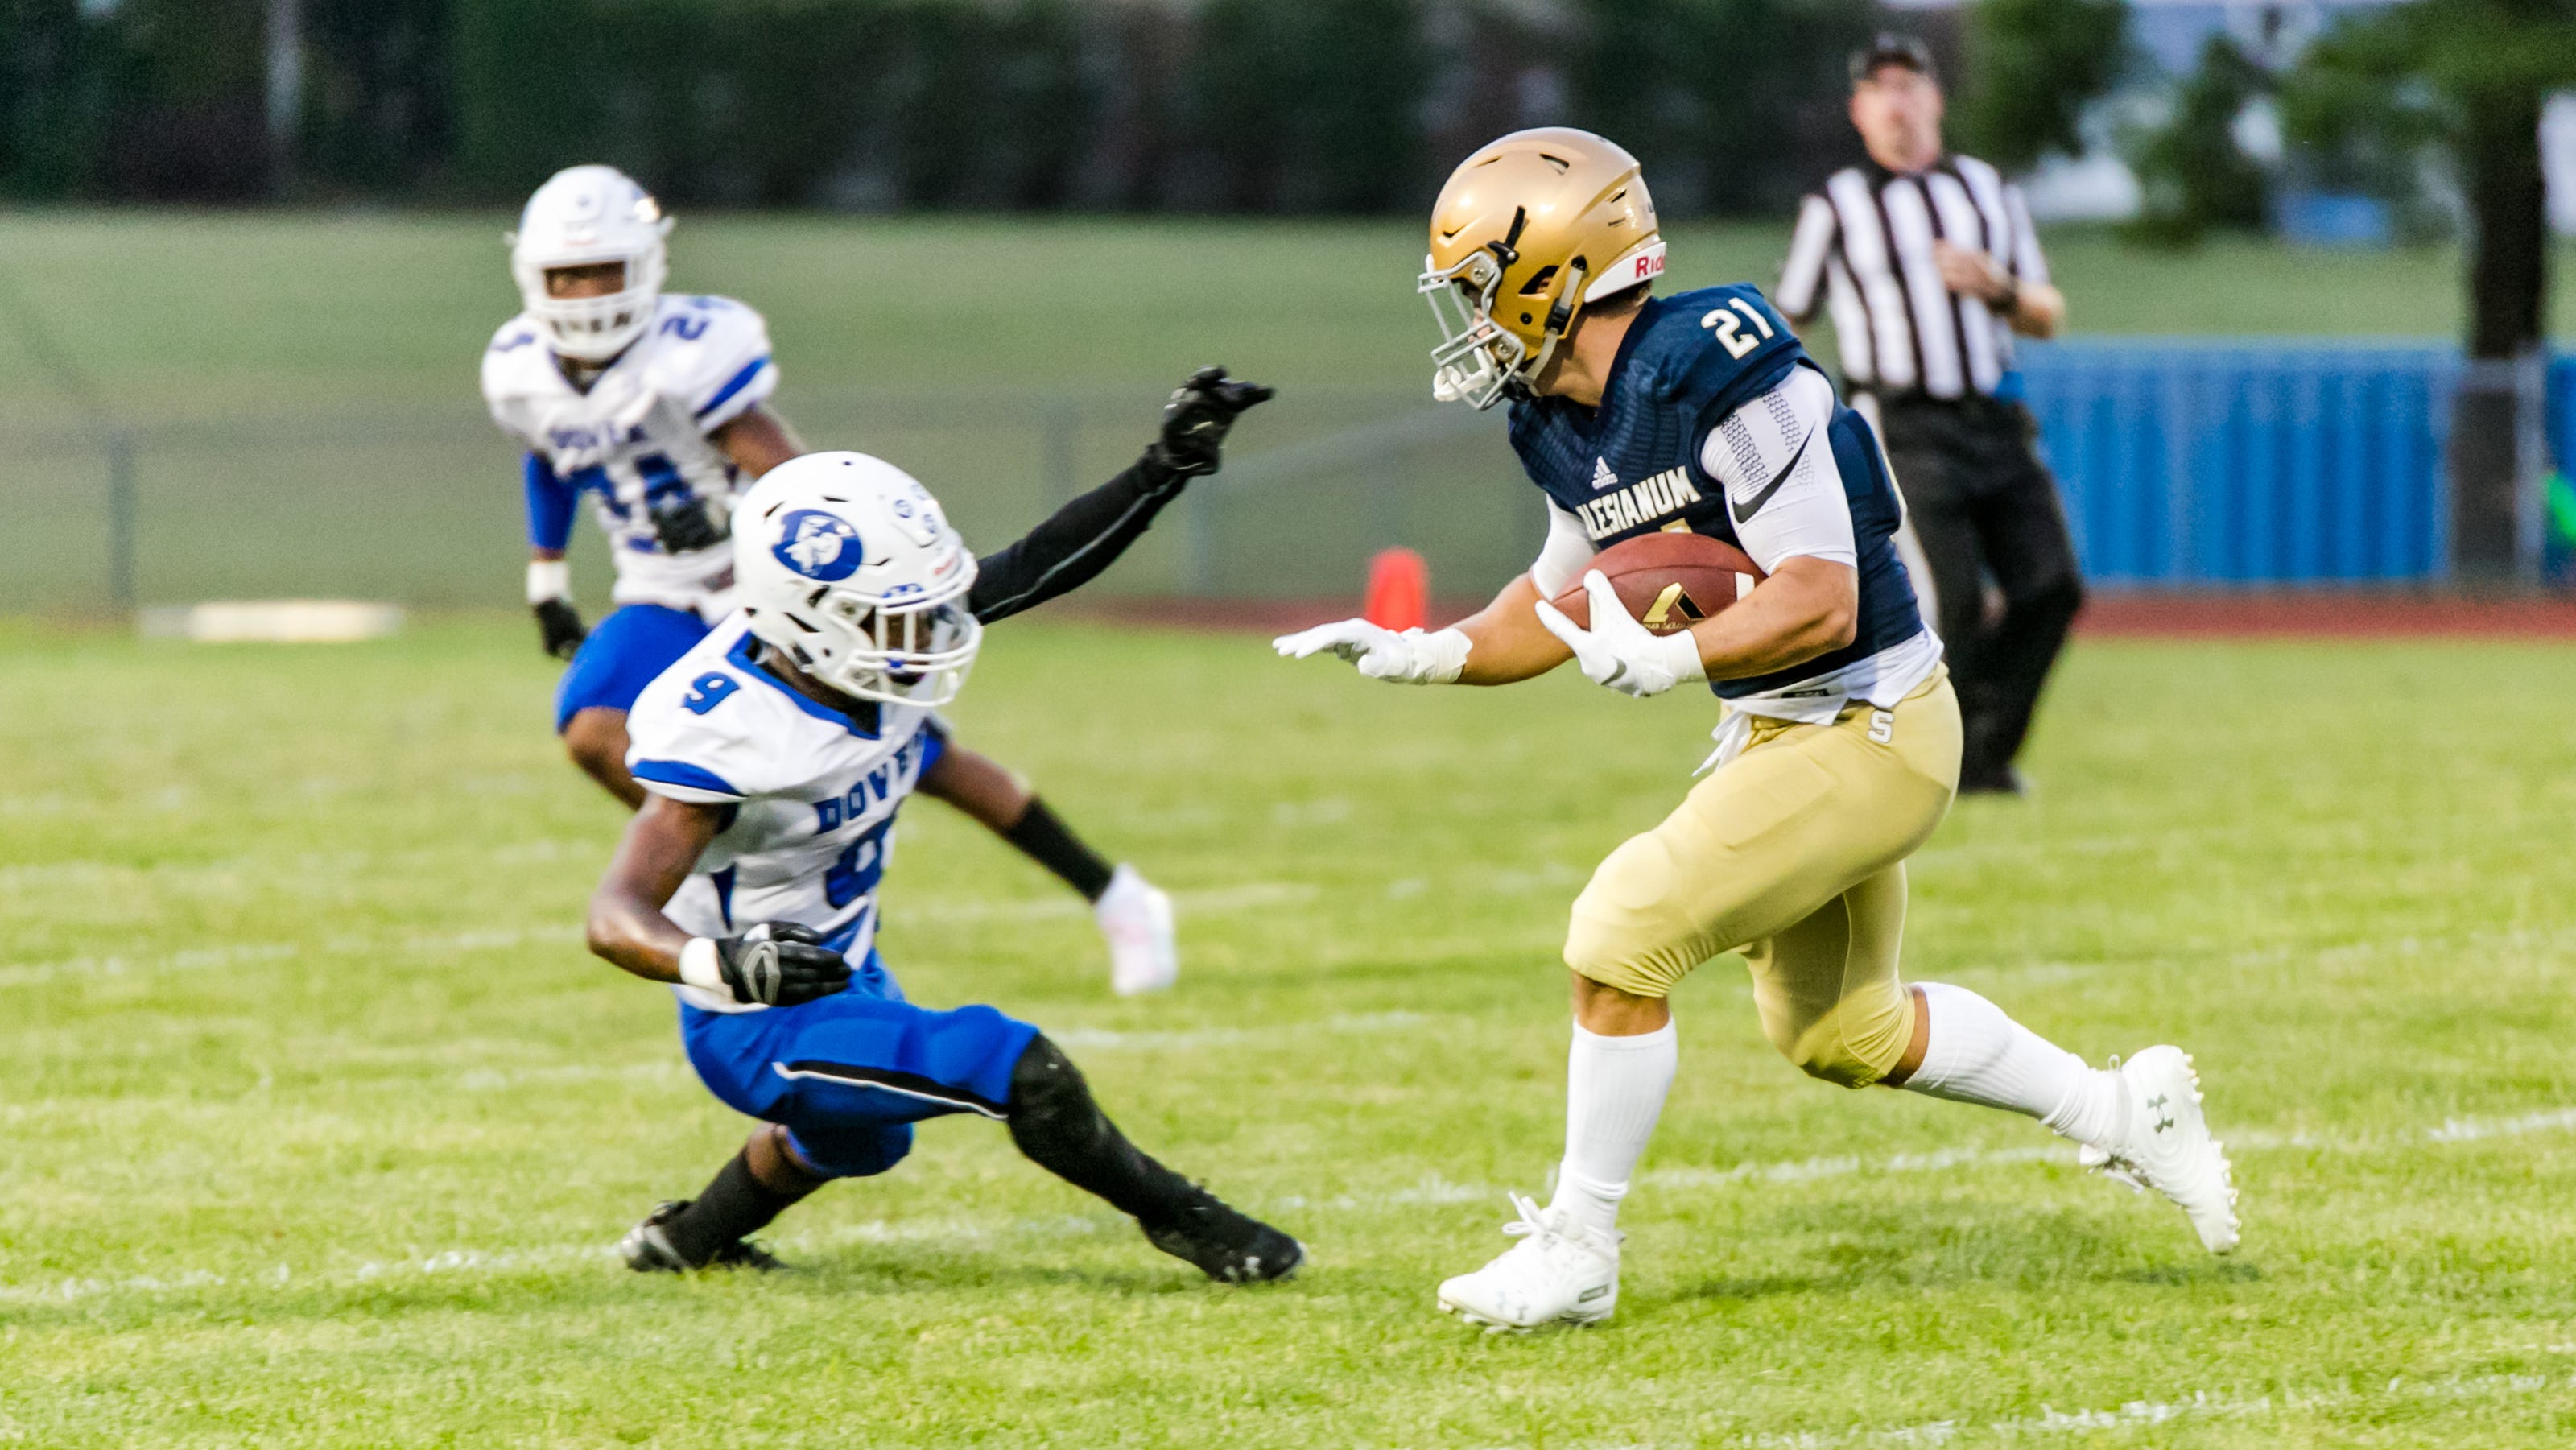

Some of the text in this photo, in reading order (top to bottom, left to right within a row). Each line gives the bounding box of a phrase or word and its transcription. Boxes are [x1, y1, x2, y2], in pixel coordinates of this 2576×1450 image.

[1700, 296, 1774, 360] 21
[680, 671, 741, 716] 9
[1868, 709, 1894, 744] S
